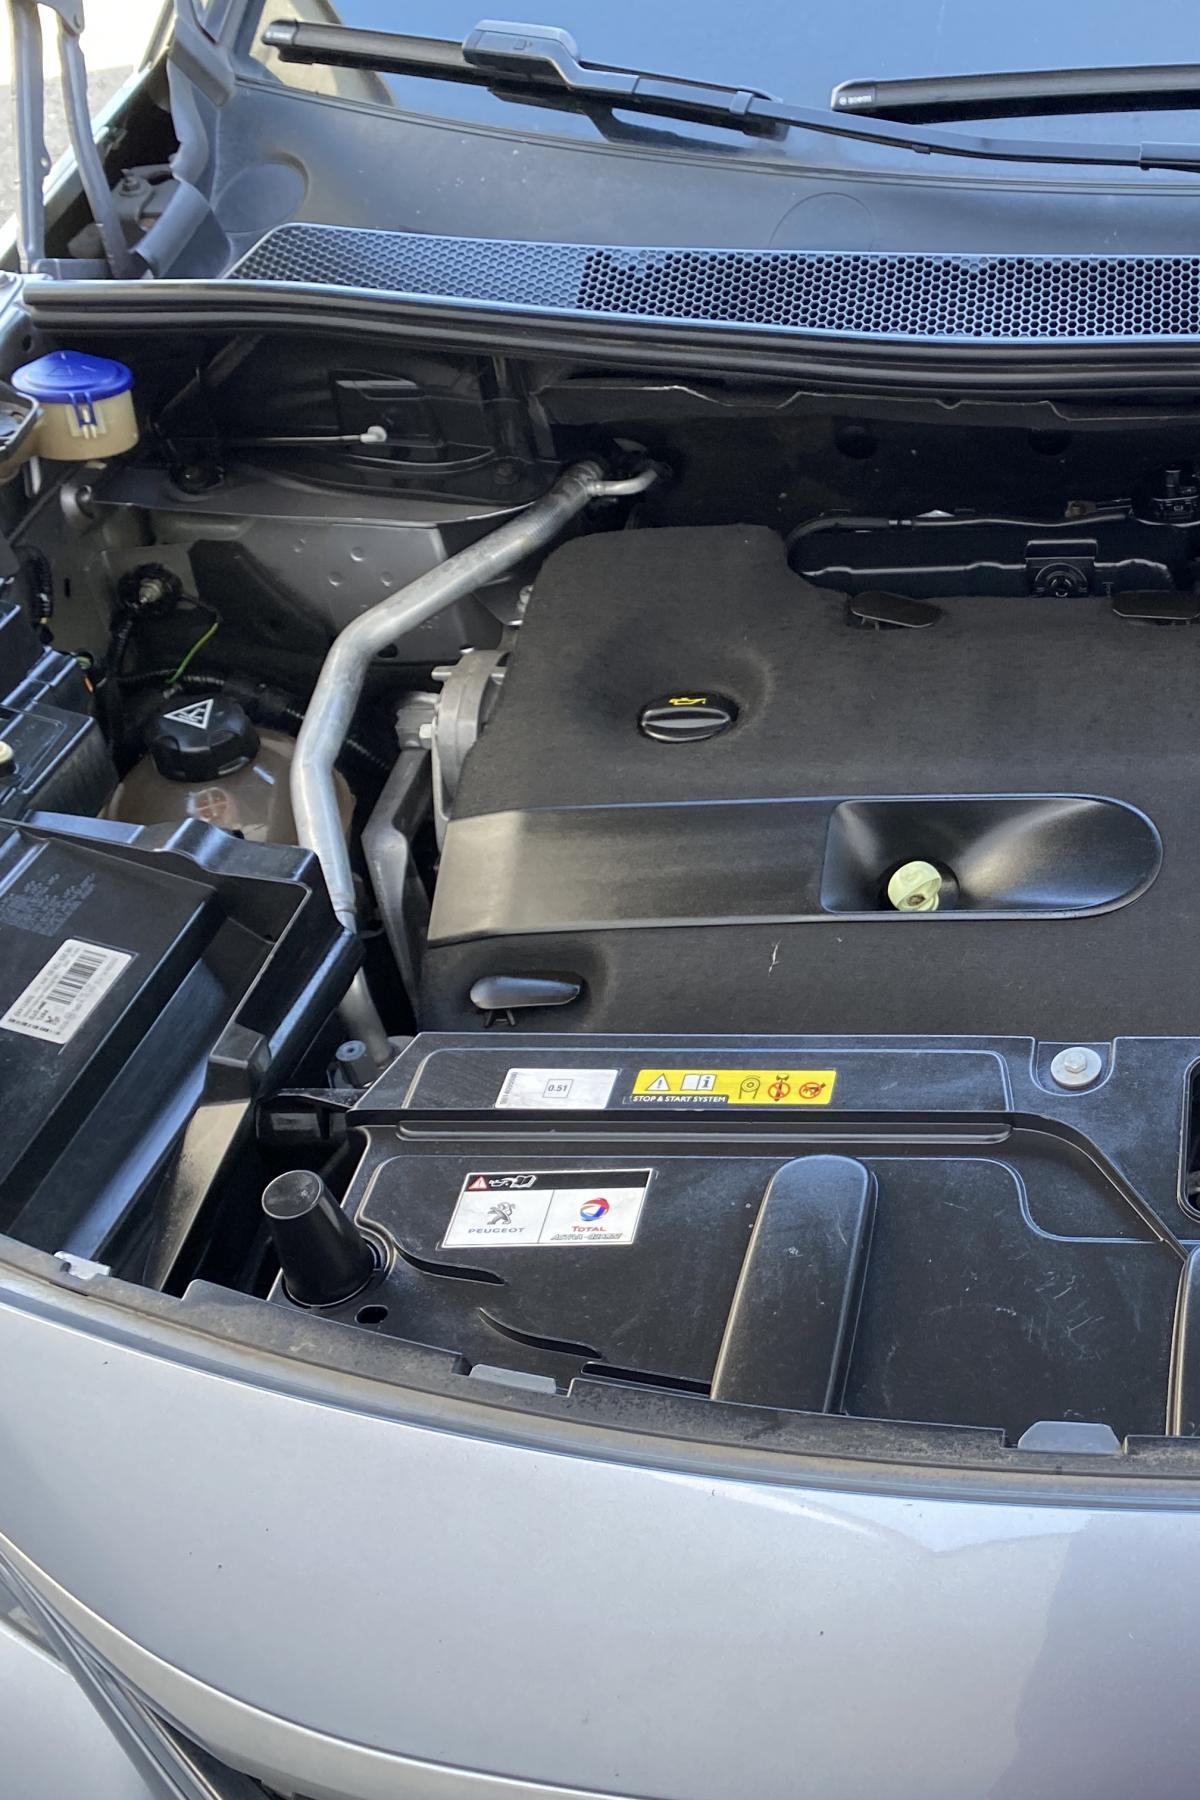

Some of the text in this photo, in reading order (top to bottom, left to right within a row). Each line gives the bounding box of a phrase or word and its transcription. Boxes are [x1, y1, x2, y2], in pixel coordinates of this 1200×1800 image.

[547, 1084, 568, 1092] 0.51
[632, 1095, 727, 1103] STOP & START SYSTEM
[571, 1225, 607, 1233] TOTAL
